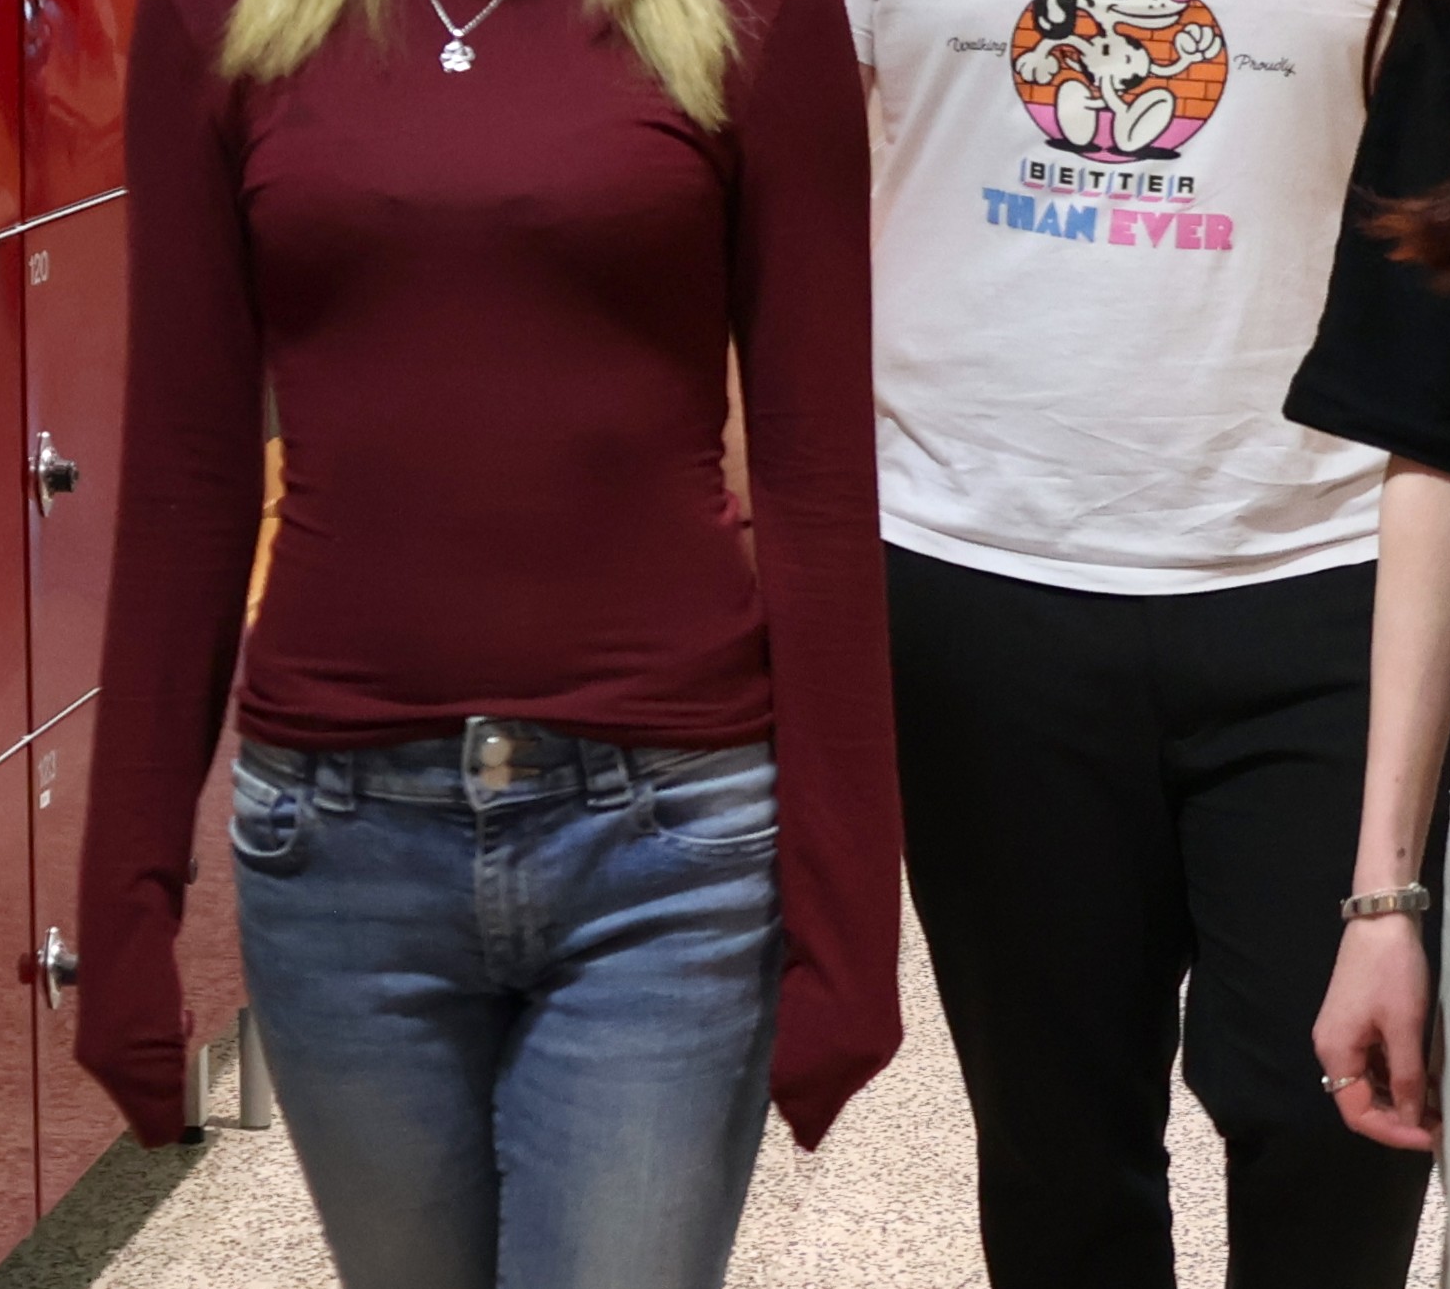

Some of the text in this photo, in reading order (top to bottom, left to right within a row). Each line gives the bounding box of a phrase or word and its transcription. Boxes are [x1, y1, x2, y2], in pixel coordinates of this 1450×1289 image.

[1233, 54, 1296, 77] Proudly
[1027, 161, 1196, 195] BETTER
[982, 187, 1234, 251] THAN EVER
[28, 251, 49, 284] 120
